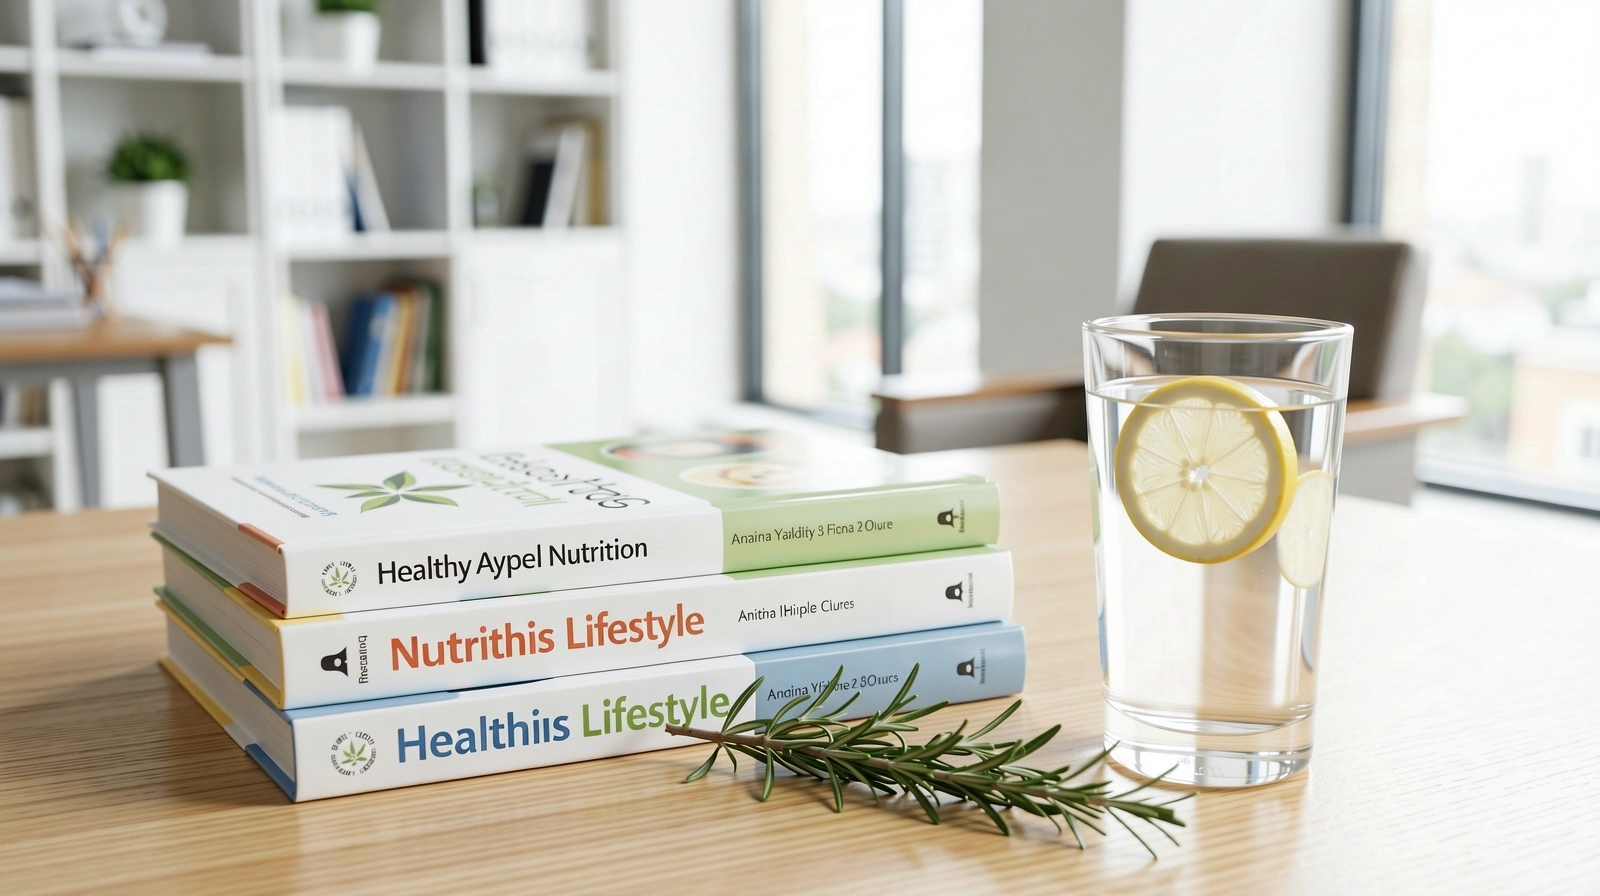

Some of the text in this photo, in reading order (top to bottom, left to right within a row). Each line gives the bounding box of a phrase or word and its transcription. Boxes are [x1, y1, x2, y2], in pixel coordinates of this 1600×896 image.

[377, 553, 472, 584] Healthy
[476, 544, 542, 580] Aypel
[549, 537, 648, 567] Nutrition
[391, 604, 705, 671] Nutrithis Lifestyle
[582, 684, 730, 738] Lifestyle
